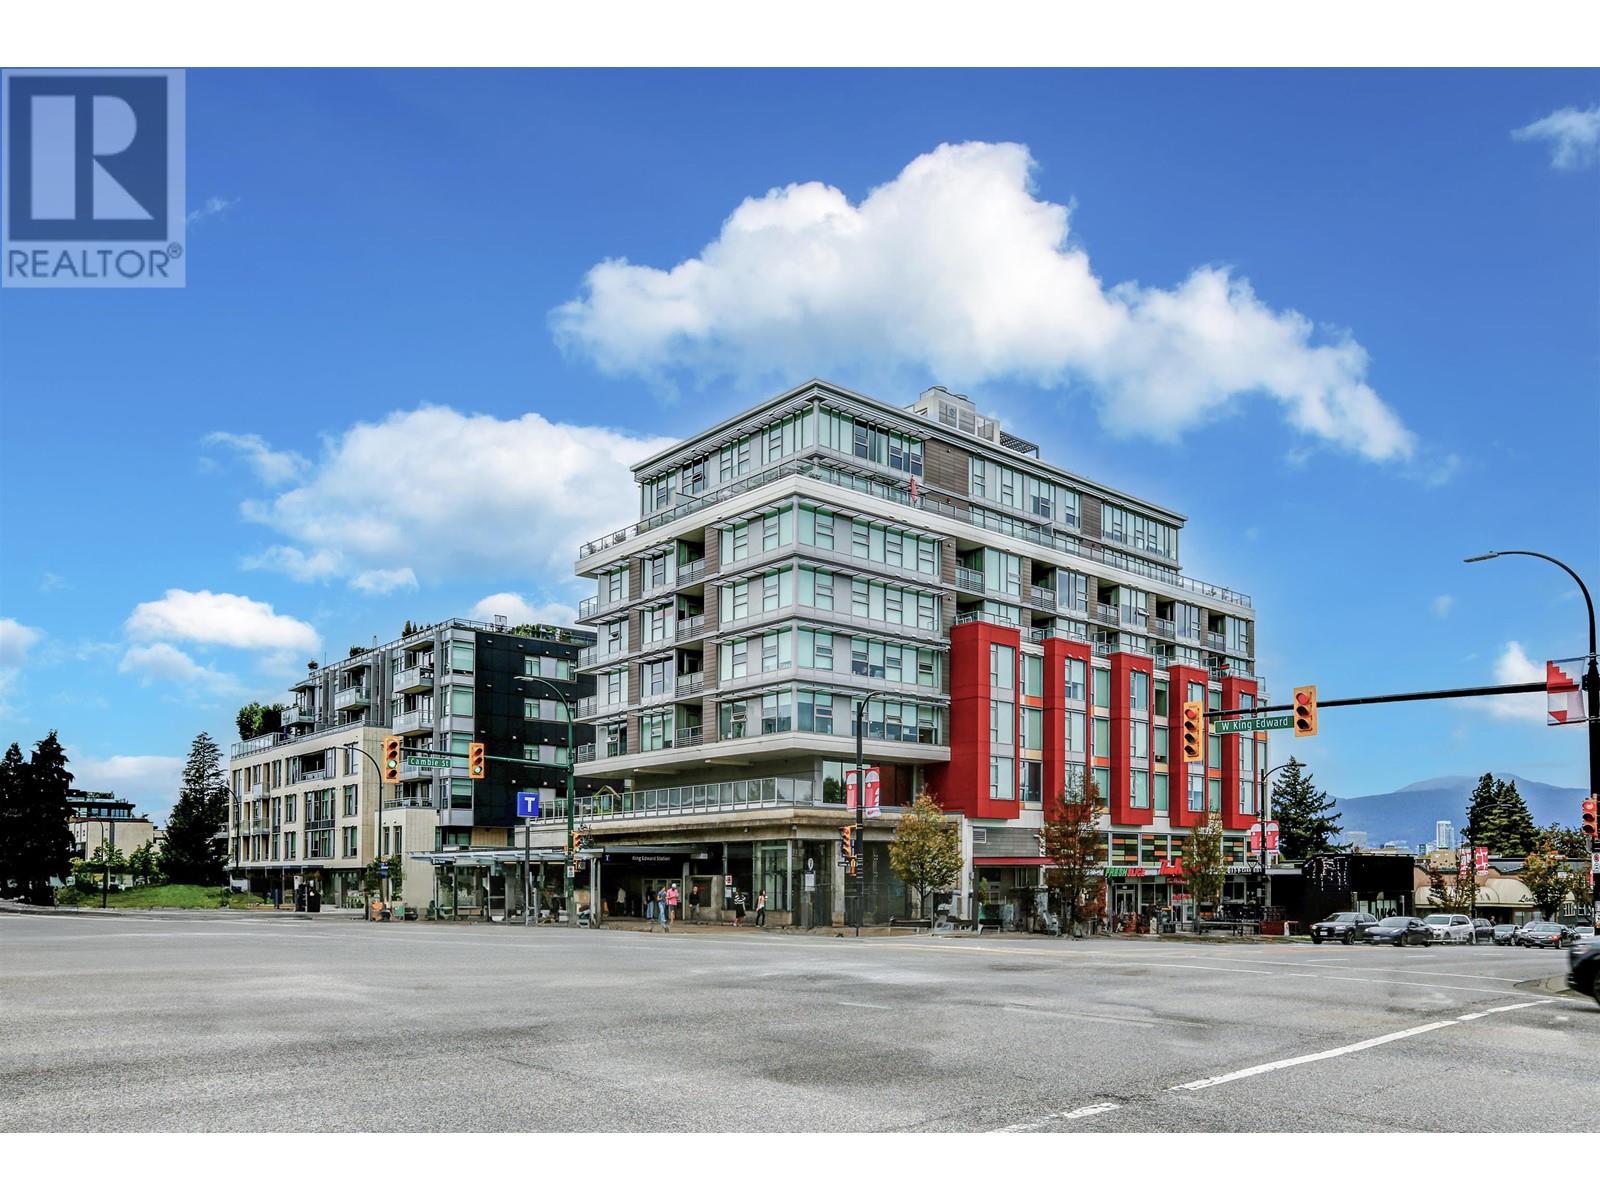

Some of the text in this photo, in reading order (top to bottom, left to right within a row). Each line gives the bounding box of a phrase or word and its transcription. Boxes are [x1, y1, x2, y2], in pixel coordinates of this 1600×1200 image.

[1221, 717, 1288, 731] W King Edward
[410, 757, 449, 767] Cambie St
[524, 796, 535, 812] T
